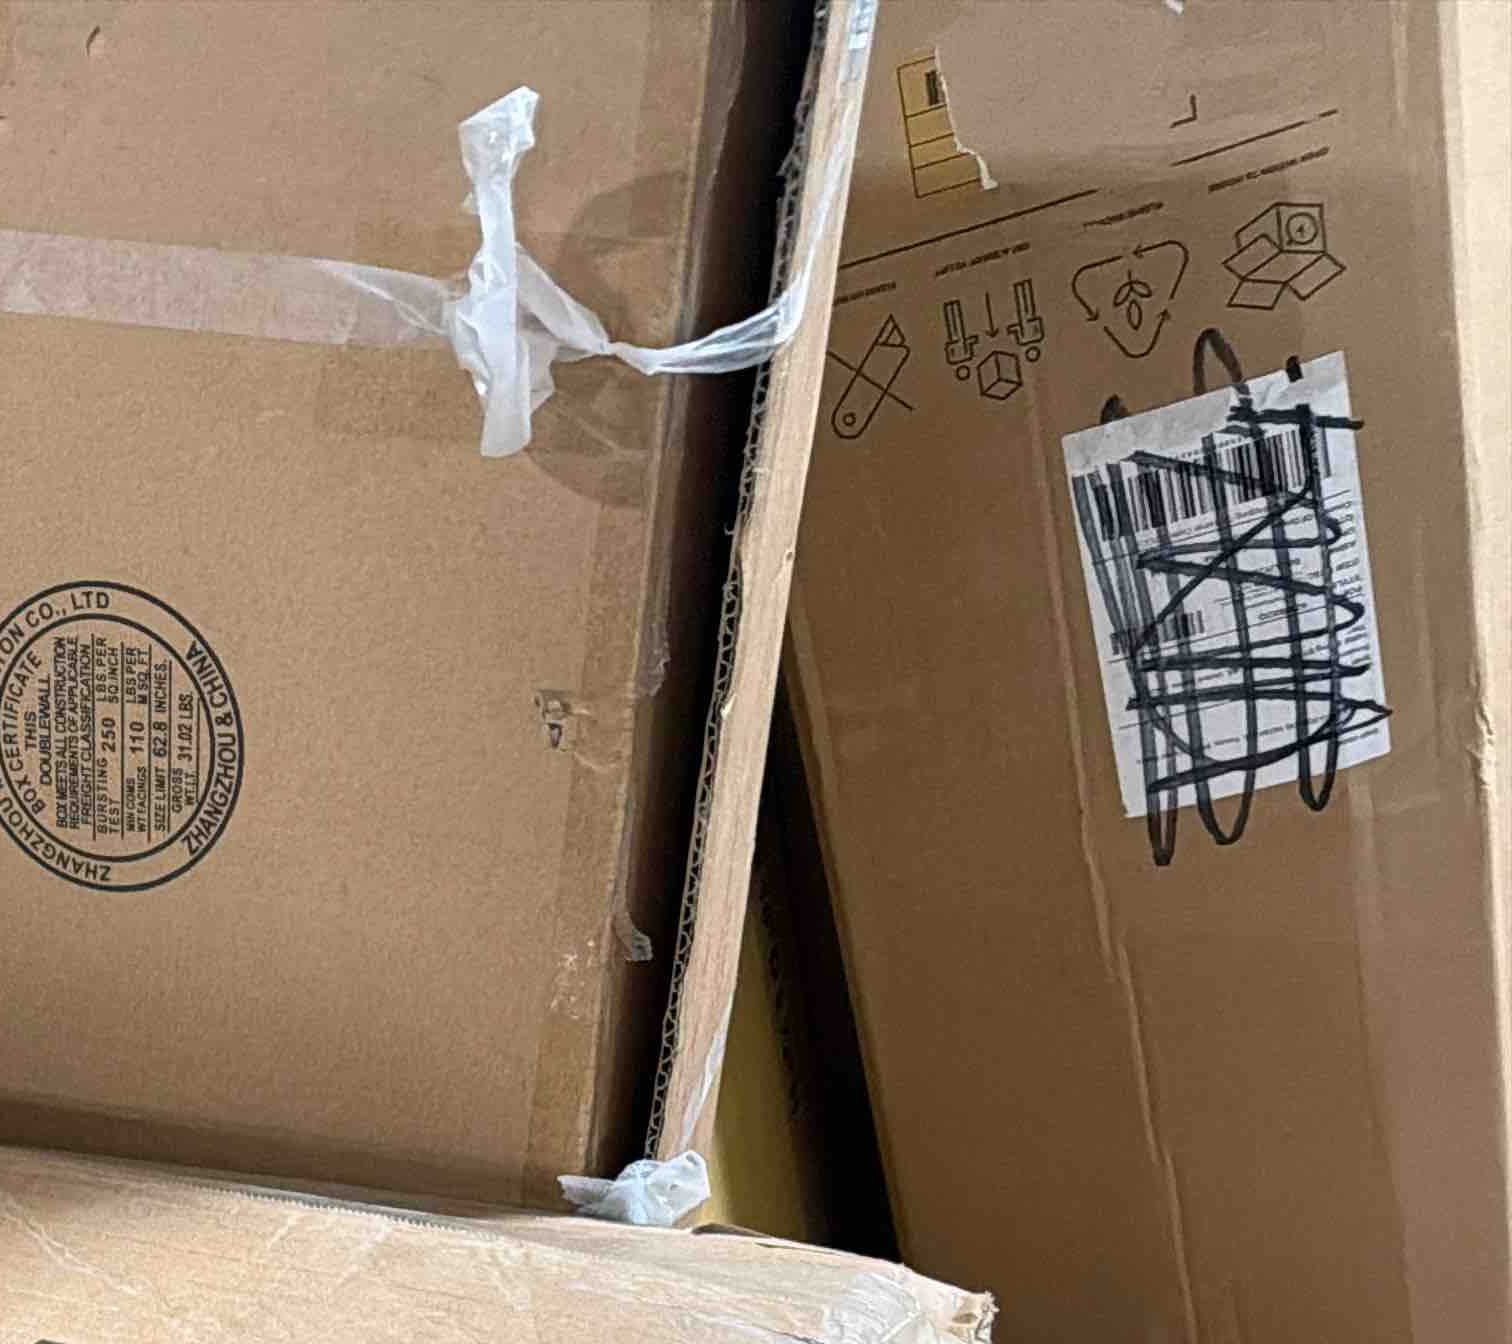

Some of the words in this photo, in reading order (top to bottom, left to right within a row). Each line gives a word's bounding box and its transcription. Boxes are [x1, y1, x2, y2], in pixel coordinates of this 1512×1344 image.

[70, 591, 110, 610] LTD
[54, 636, 67, 733] CONSTRUCTION
[67, 634, 78, 712] APPLICABLE
[186, 640, 228, 708] CHINA
[2, 651, 42, 771] CERTIFICATE
[79, 643, 91, 761] CLASSIFICATION
[215, 711, 234, 727] &
[24, 711, 37, 751] THIS
[55, 736, 67, 757] ALL
[101, 717, 116, 752] 250
[129, 721, 145, 754] 110
[153, 721, 168, 758] 62.8
[15, 774, 47, 814] BOX
[68, 736, 80, 829] REQUIREMENTS
[80, 767, 92, 826] FREIGHT
[96, 758, 108, 834] BURSTING
[137, 766, 146, 814] FACINGS
[155, 766, 165, 801] LIMIT
[171, 767, 183, 813] GROSS
[182, 732, 236, 857] ZHANGZHOU
[109, 798, 121, 834] TEST
[126, 811, 136, 832] MIN
[154, 801, 166, 832] SIZE
